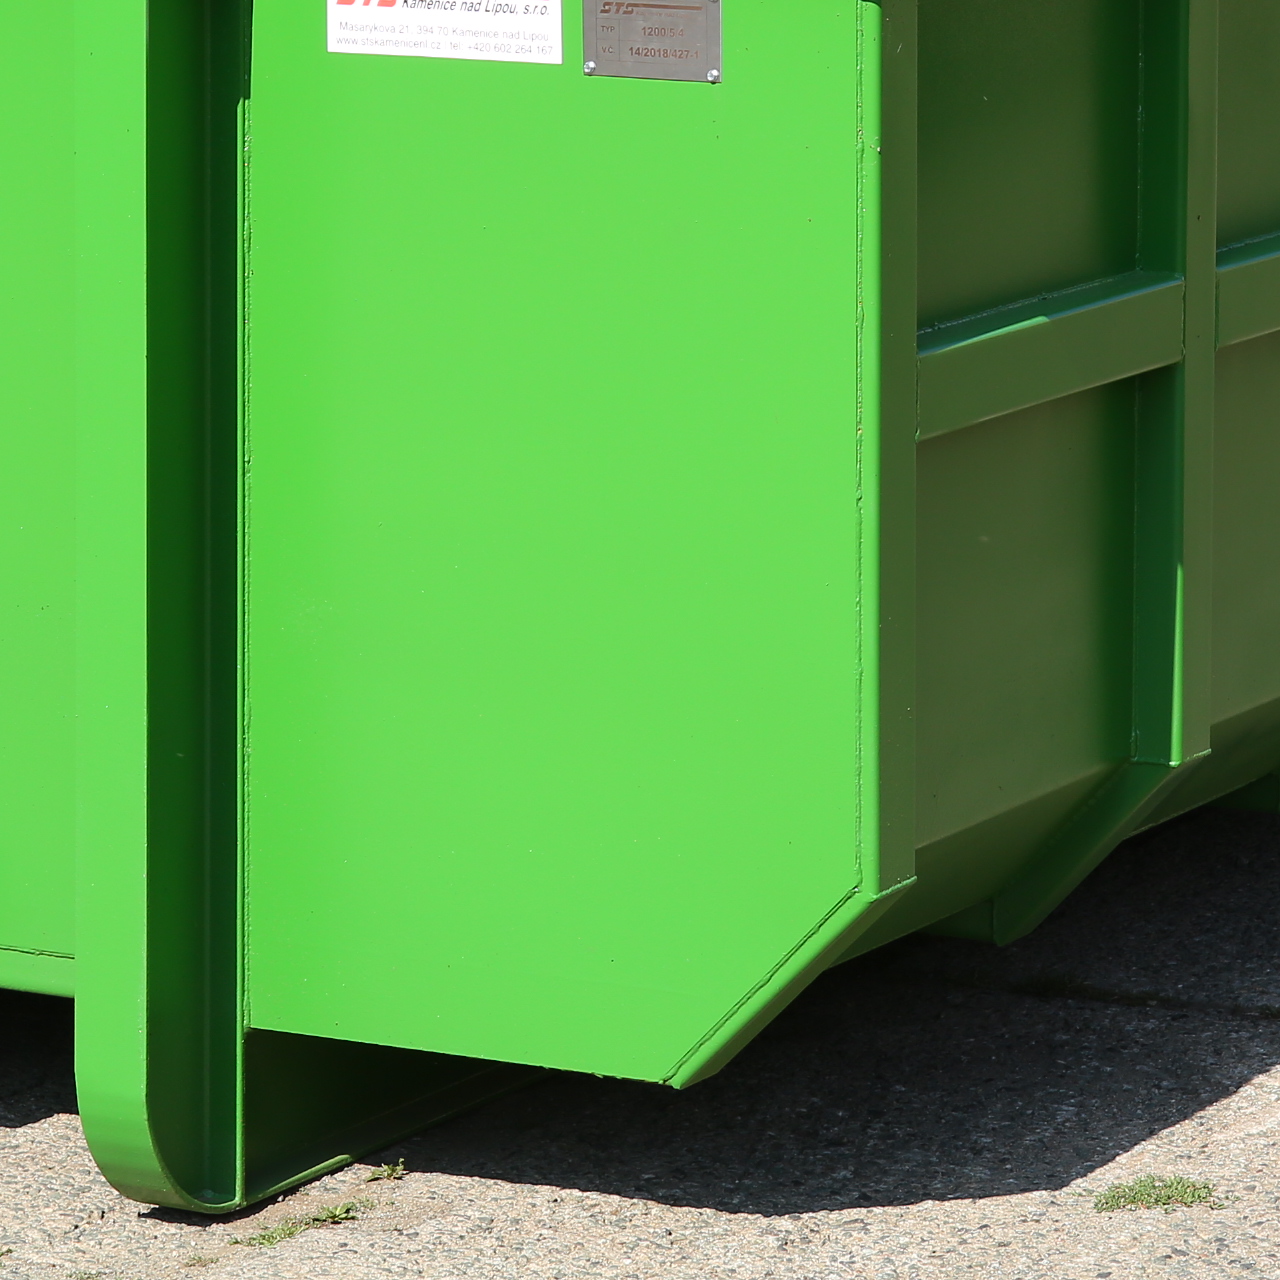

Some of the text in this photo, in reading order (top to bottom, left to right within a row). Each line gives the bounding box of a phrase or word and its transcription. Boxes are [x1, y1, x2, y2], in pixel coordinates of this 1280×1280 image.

[460, 0, 480, 12] nad
[485, 0, 518, 16] Lipou,
[523, 5, 550, 16] s.r.o.
[599, 1, 634, 15] STS
[339, 22, 396, 33] Masarykova
[416, 26, 434, 35] 394
[437, 27, 449, 36] 70
[452, 27, 499, 39] Kamenice
[502, 30, 520, 39] nad
[523, 31, 549, 42] Lipou
[600, 25, 615, 33] TYP
[467, 43, 491, 52] +420
[494, 43, 512, 53] 602
[515, 45, 532, 54] 264
[536, 46, 553, 55] 167
[628, 46, 699, 59] 14/2018/427-1
